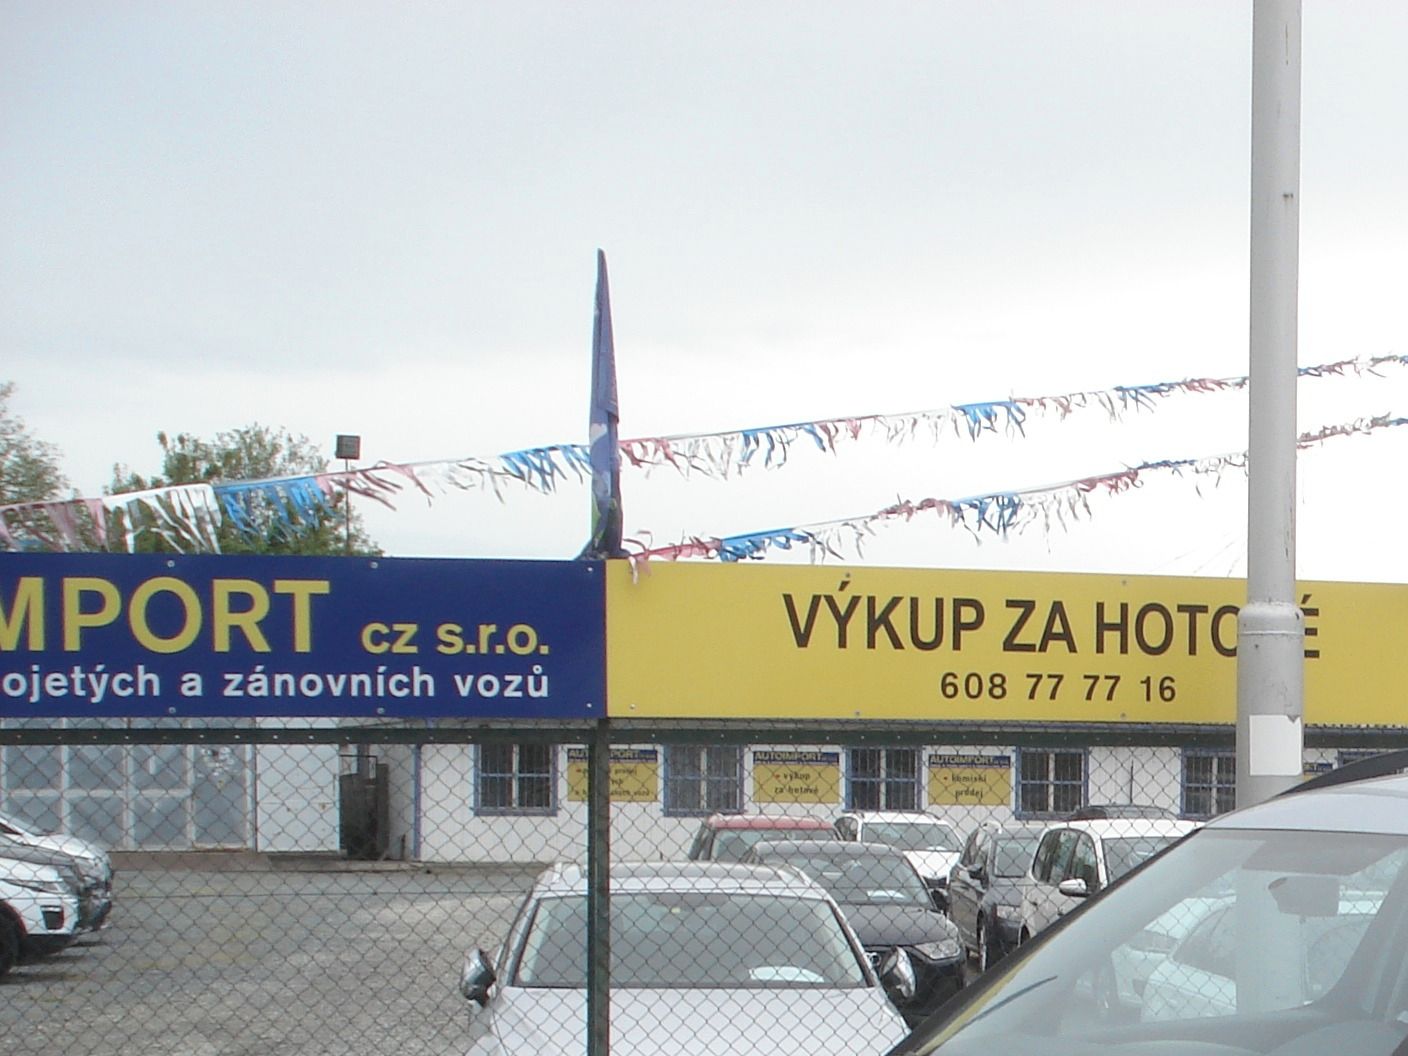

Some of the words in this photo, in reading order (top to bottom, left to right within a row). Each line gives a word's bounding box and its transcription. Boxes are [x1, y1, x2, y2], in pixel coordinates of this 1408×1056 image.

[781, 581, 985, 653] VÝKUP
[1002, 598, 1078, 655] ZA
[1096, 593, 1321, 659] HOTOÉ
[361, 622, 418, 655] cz
[436, 623, 549, 655] s.r.o.
[2, 664, 161, 703] ojetých
[180, 673, 203, 697] a
[223, 664, 436, 698] zánovních
[454, 663, 549, 699] vozů
[940, 672, 1008, 701] 608
[1025, 674, 1065, 702] 77
[1082, 675, 1121, 702] 77
[1140, 676, 1177, 703] 16
